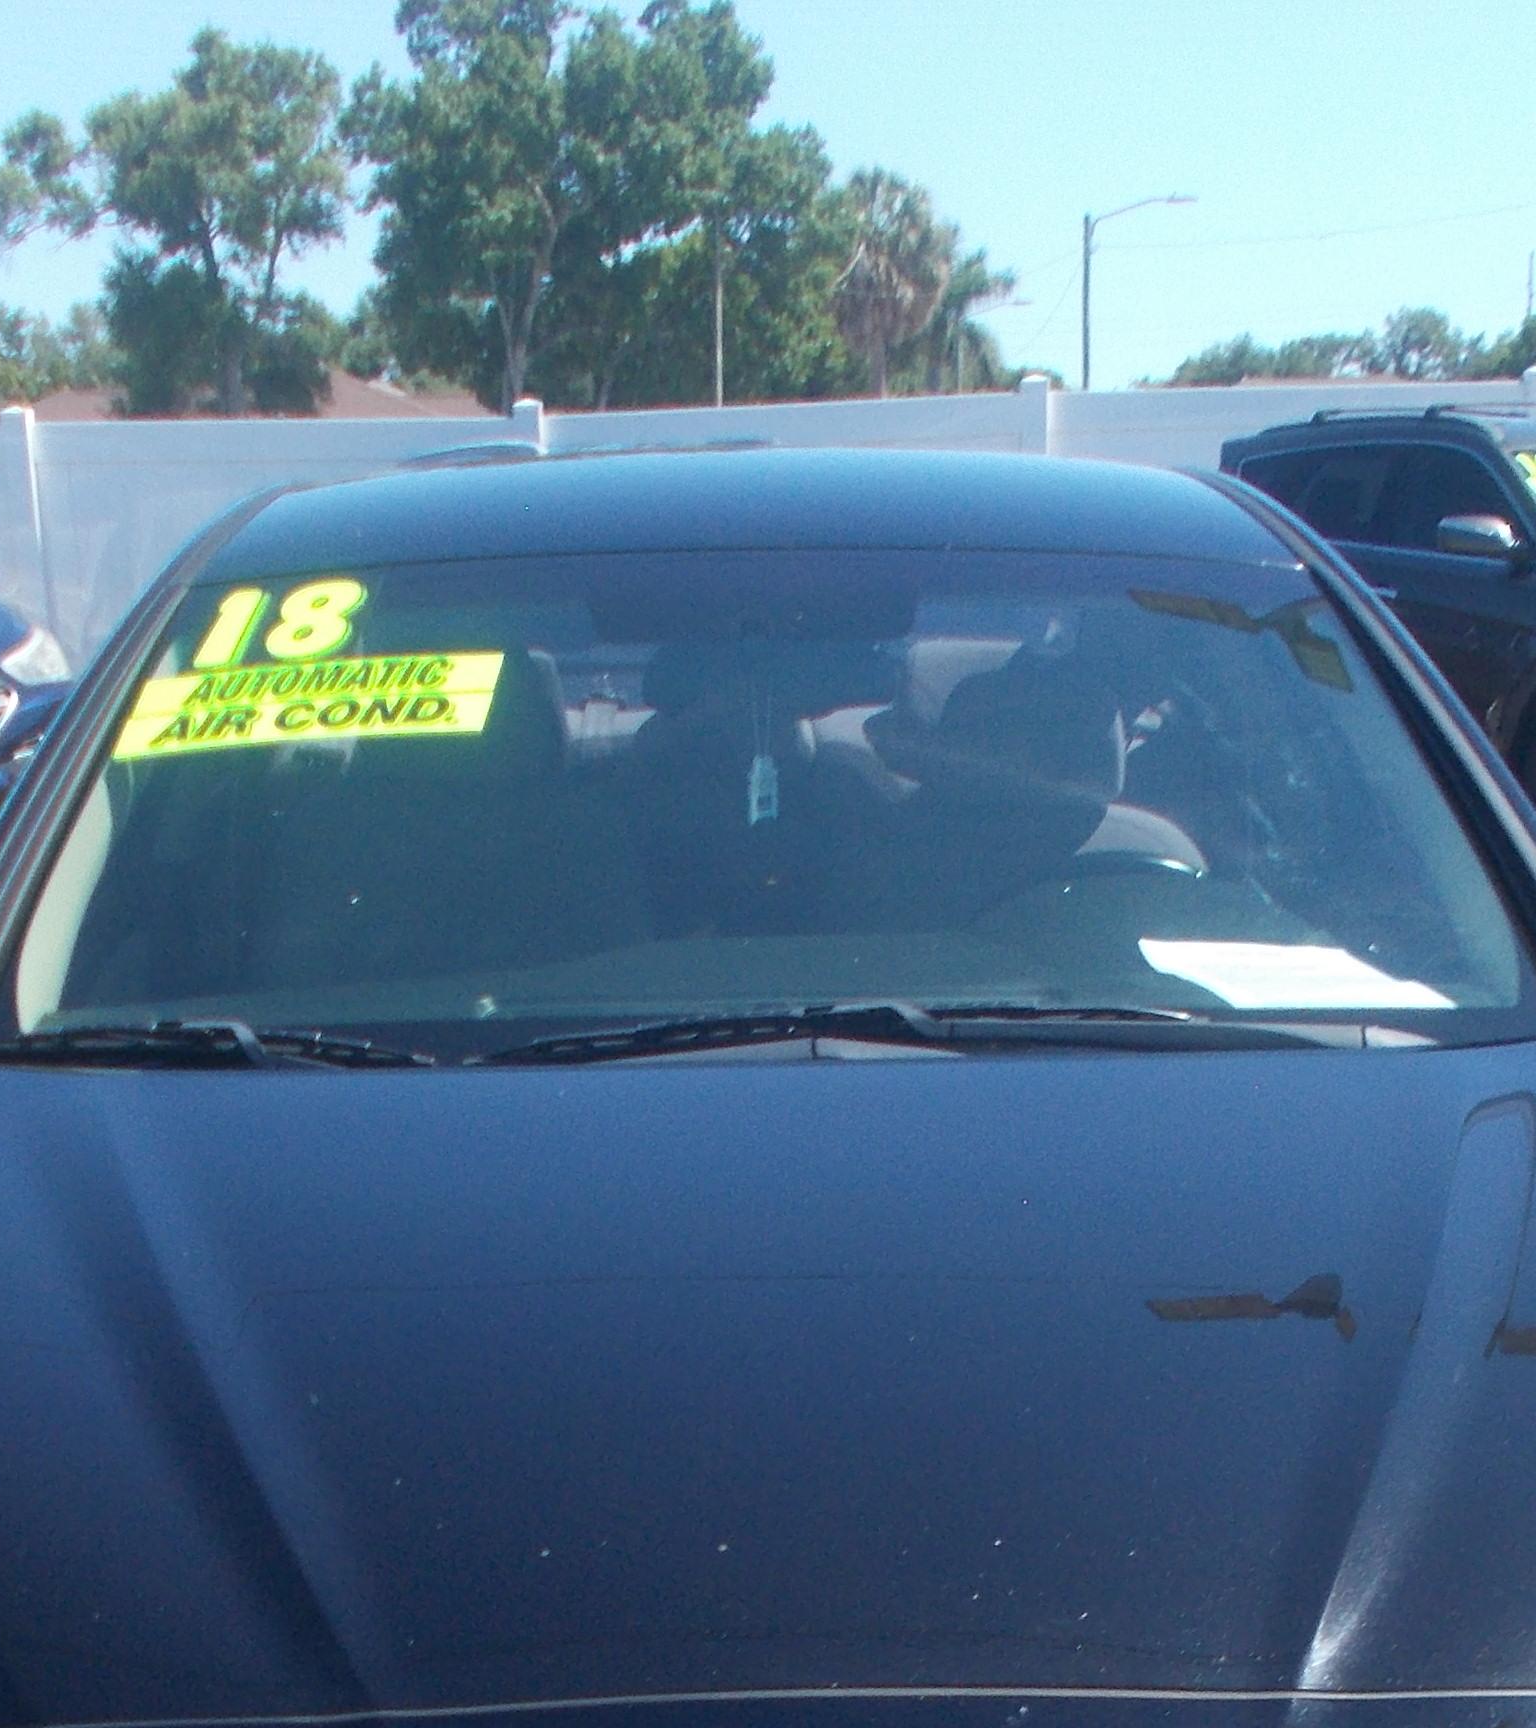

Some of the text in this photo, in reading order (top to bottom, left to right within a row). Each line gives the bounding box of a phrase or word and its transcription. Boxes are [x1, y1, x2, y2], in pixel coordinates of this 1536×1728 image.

[193, 577, 367, 669] 18
[181, 656, 453, 709] AUTOMATIC
[148, 695, 458, 746] AIR COND.
